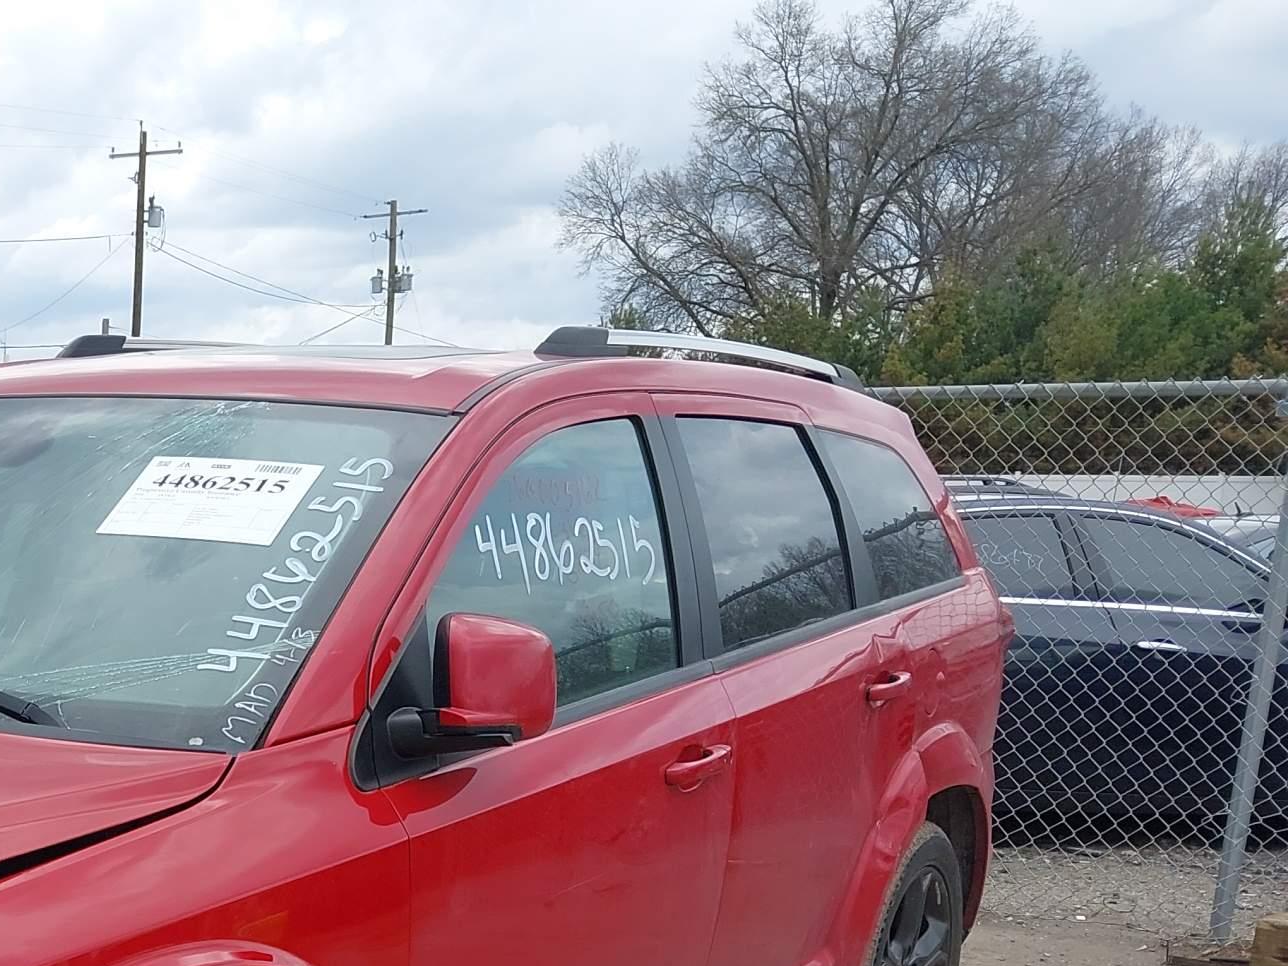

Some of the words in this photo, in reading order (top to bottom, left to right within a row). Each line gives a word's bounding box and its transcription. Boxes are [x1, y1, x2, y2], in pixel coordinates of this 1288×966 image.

[152, 473, 290, 494] 44862515
[197, 456, 394, 672] 44862515
[474, 512, 656, 595] 44862515
